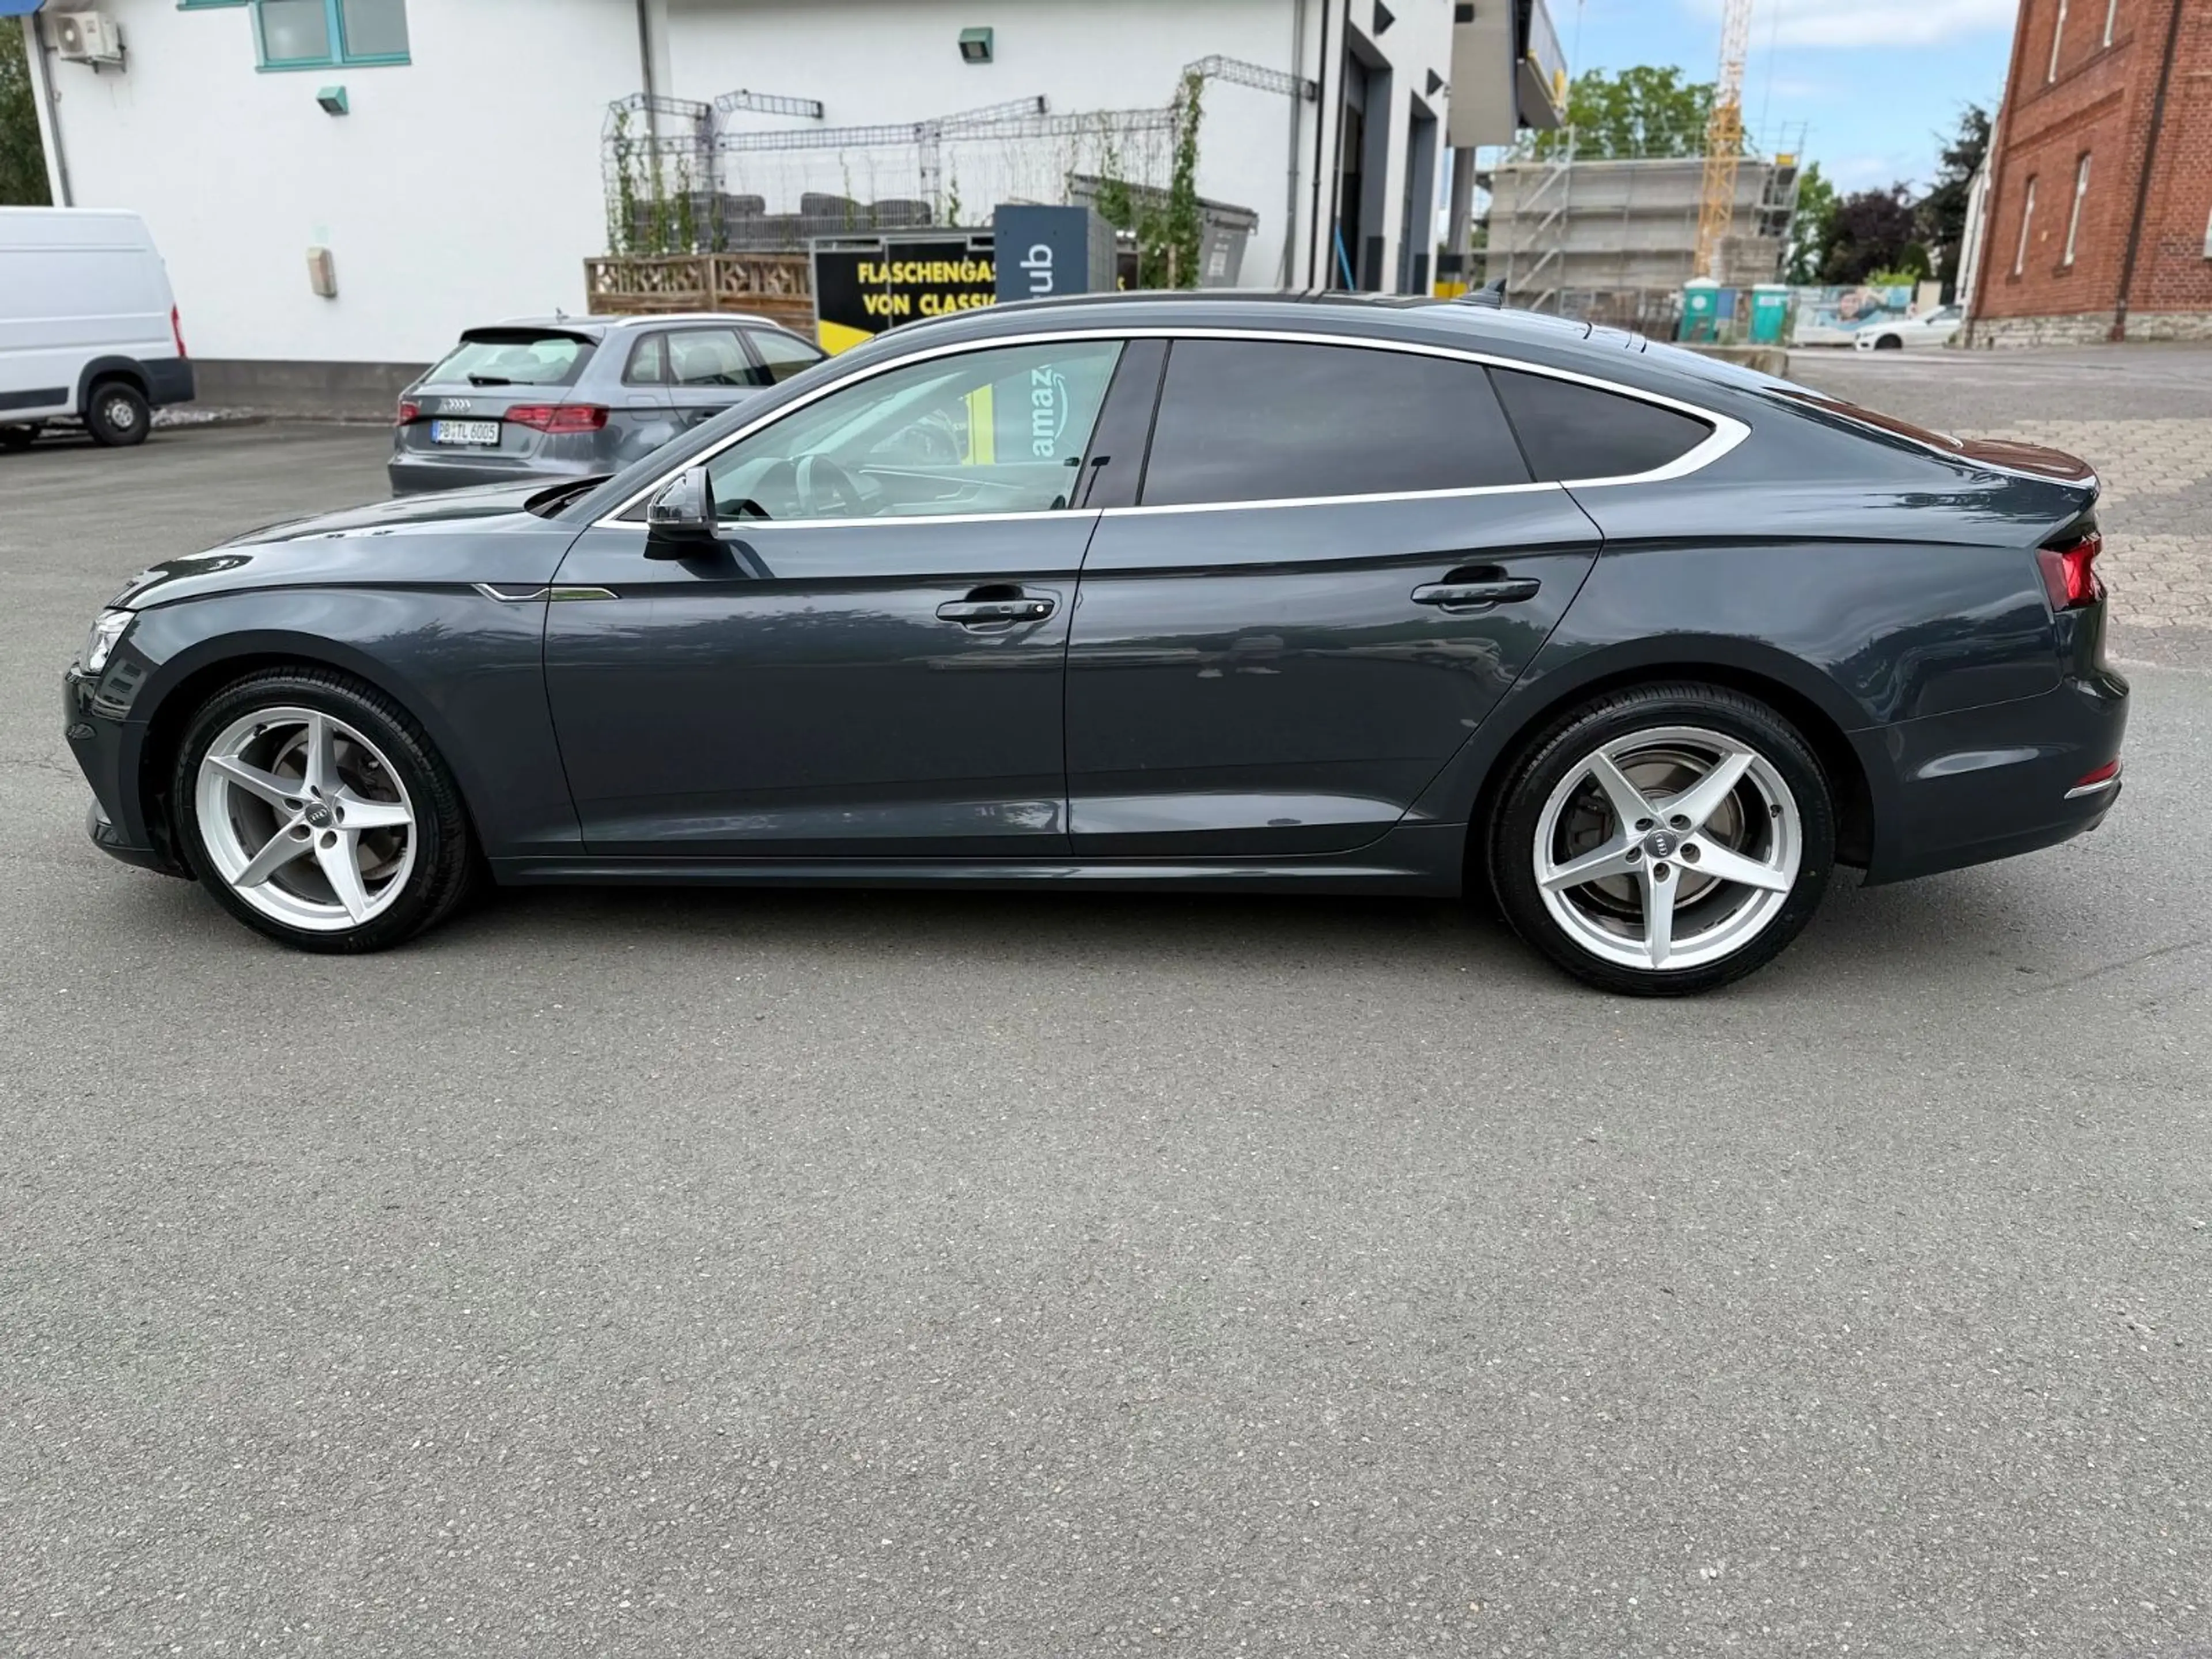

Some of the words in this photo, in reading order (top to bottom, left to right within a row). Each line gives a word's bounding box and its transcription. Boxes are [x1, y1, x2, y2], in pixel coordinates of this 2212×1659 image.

[1020, 244, 1053, 299] ub
[863, 293, 911, 315] VON
[1032, 364, 1055, 457] amaz
